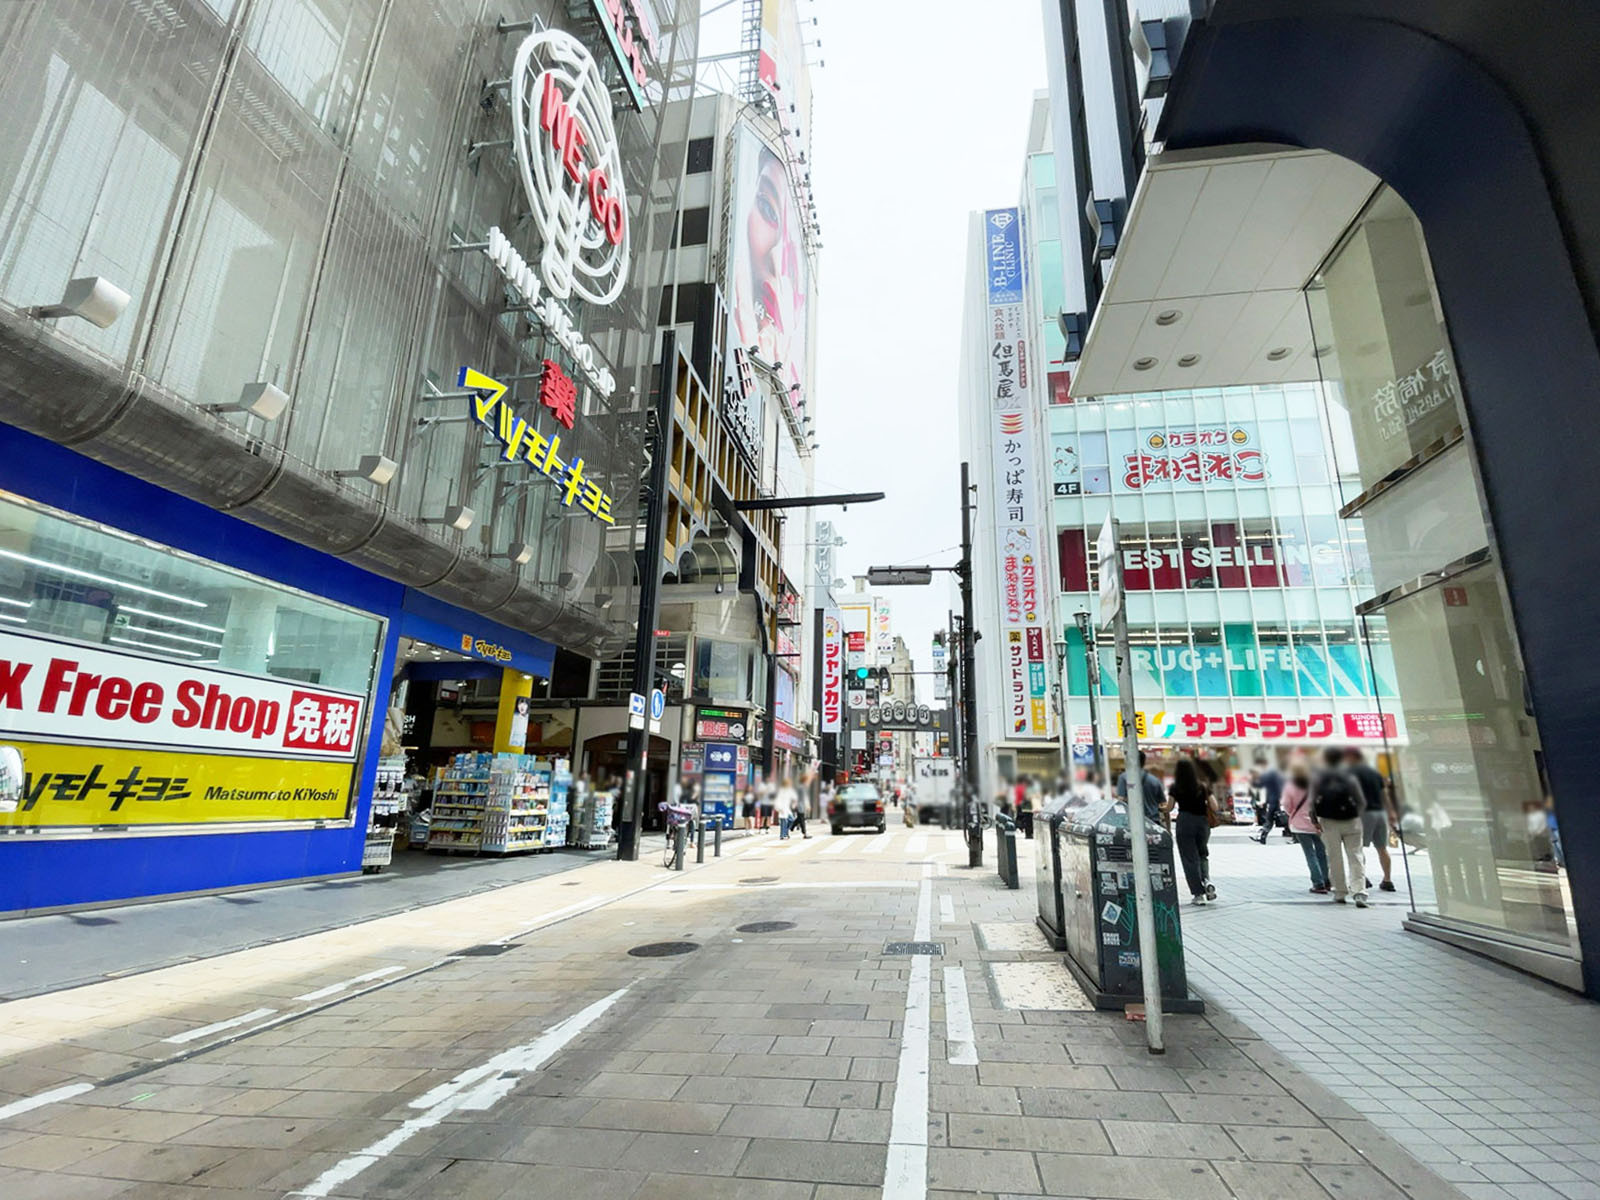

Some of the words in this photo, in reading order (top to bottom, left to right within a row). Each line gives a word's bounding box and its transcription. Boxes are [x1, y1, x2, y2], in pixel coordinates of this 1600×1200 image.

[541, 73, 624, 245] WEGO
[992, 232, 1008, 287] B-LINE
[1006, 241, 1015, 278] CLINIC
[540, 359, 577, 430] 薬
[992, 342, 1015, 399] 但馬屋
[459, 366, 616, 525] マツモトキヨシ
[1125, 450, 1267, 489] まねきねこ
[1005, 439, 1025, 522] かっぱ寿司
[1057, 483, 1077, 494] 4F
[1122, 548, 1181, 569] EST
[824, 642, 840, 723] ジャンカラ
[1010, 645, 1025, 716] サンドラッグ
[1130, 648, 1299, 671] RUG+LIFE
[38, 658, 164, 723] Free
[172, 679, 281, 739] Shop
[288, 697, 355, 746] 免税
[1181, 713, 1334, 738] サンドラッグ
[22, 764, 192, 811] ツモトキヨシ
[204, 786, 292, 801] Matsumoto
[293, 788, 339, 801] KiYoshi
